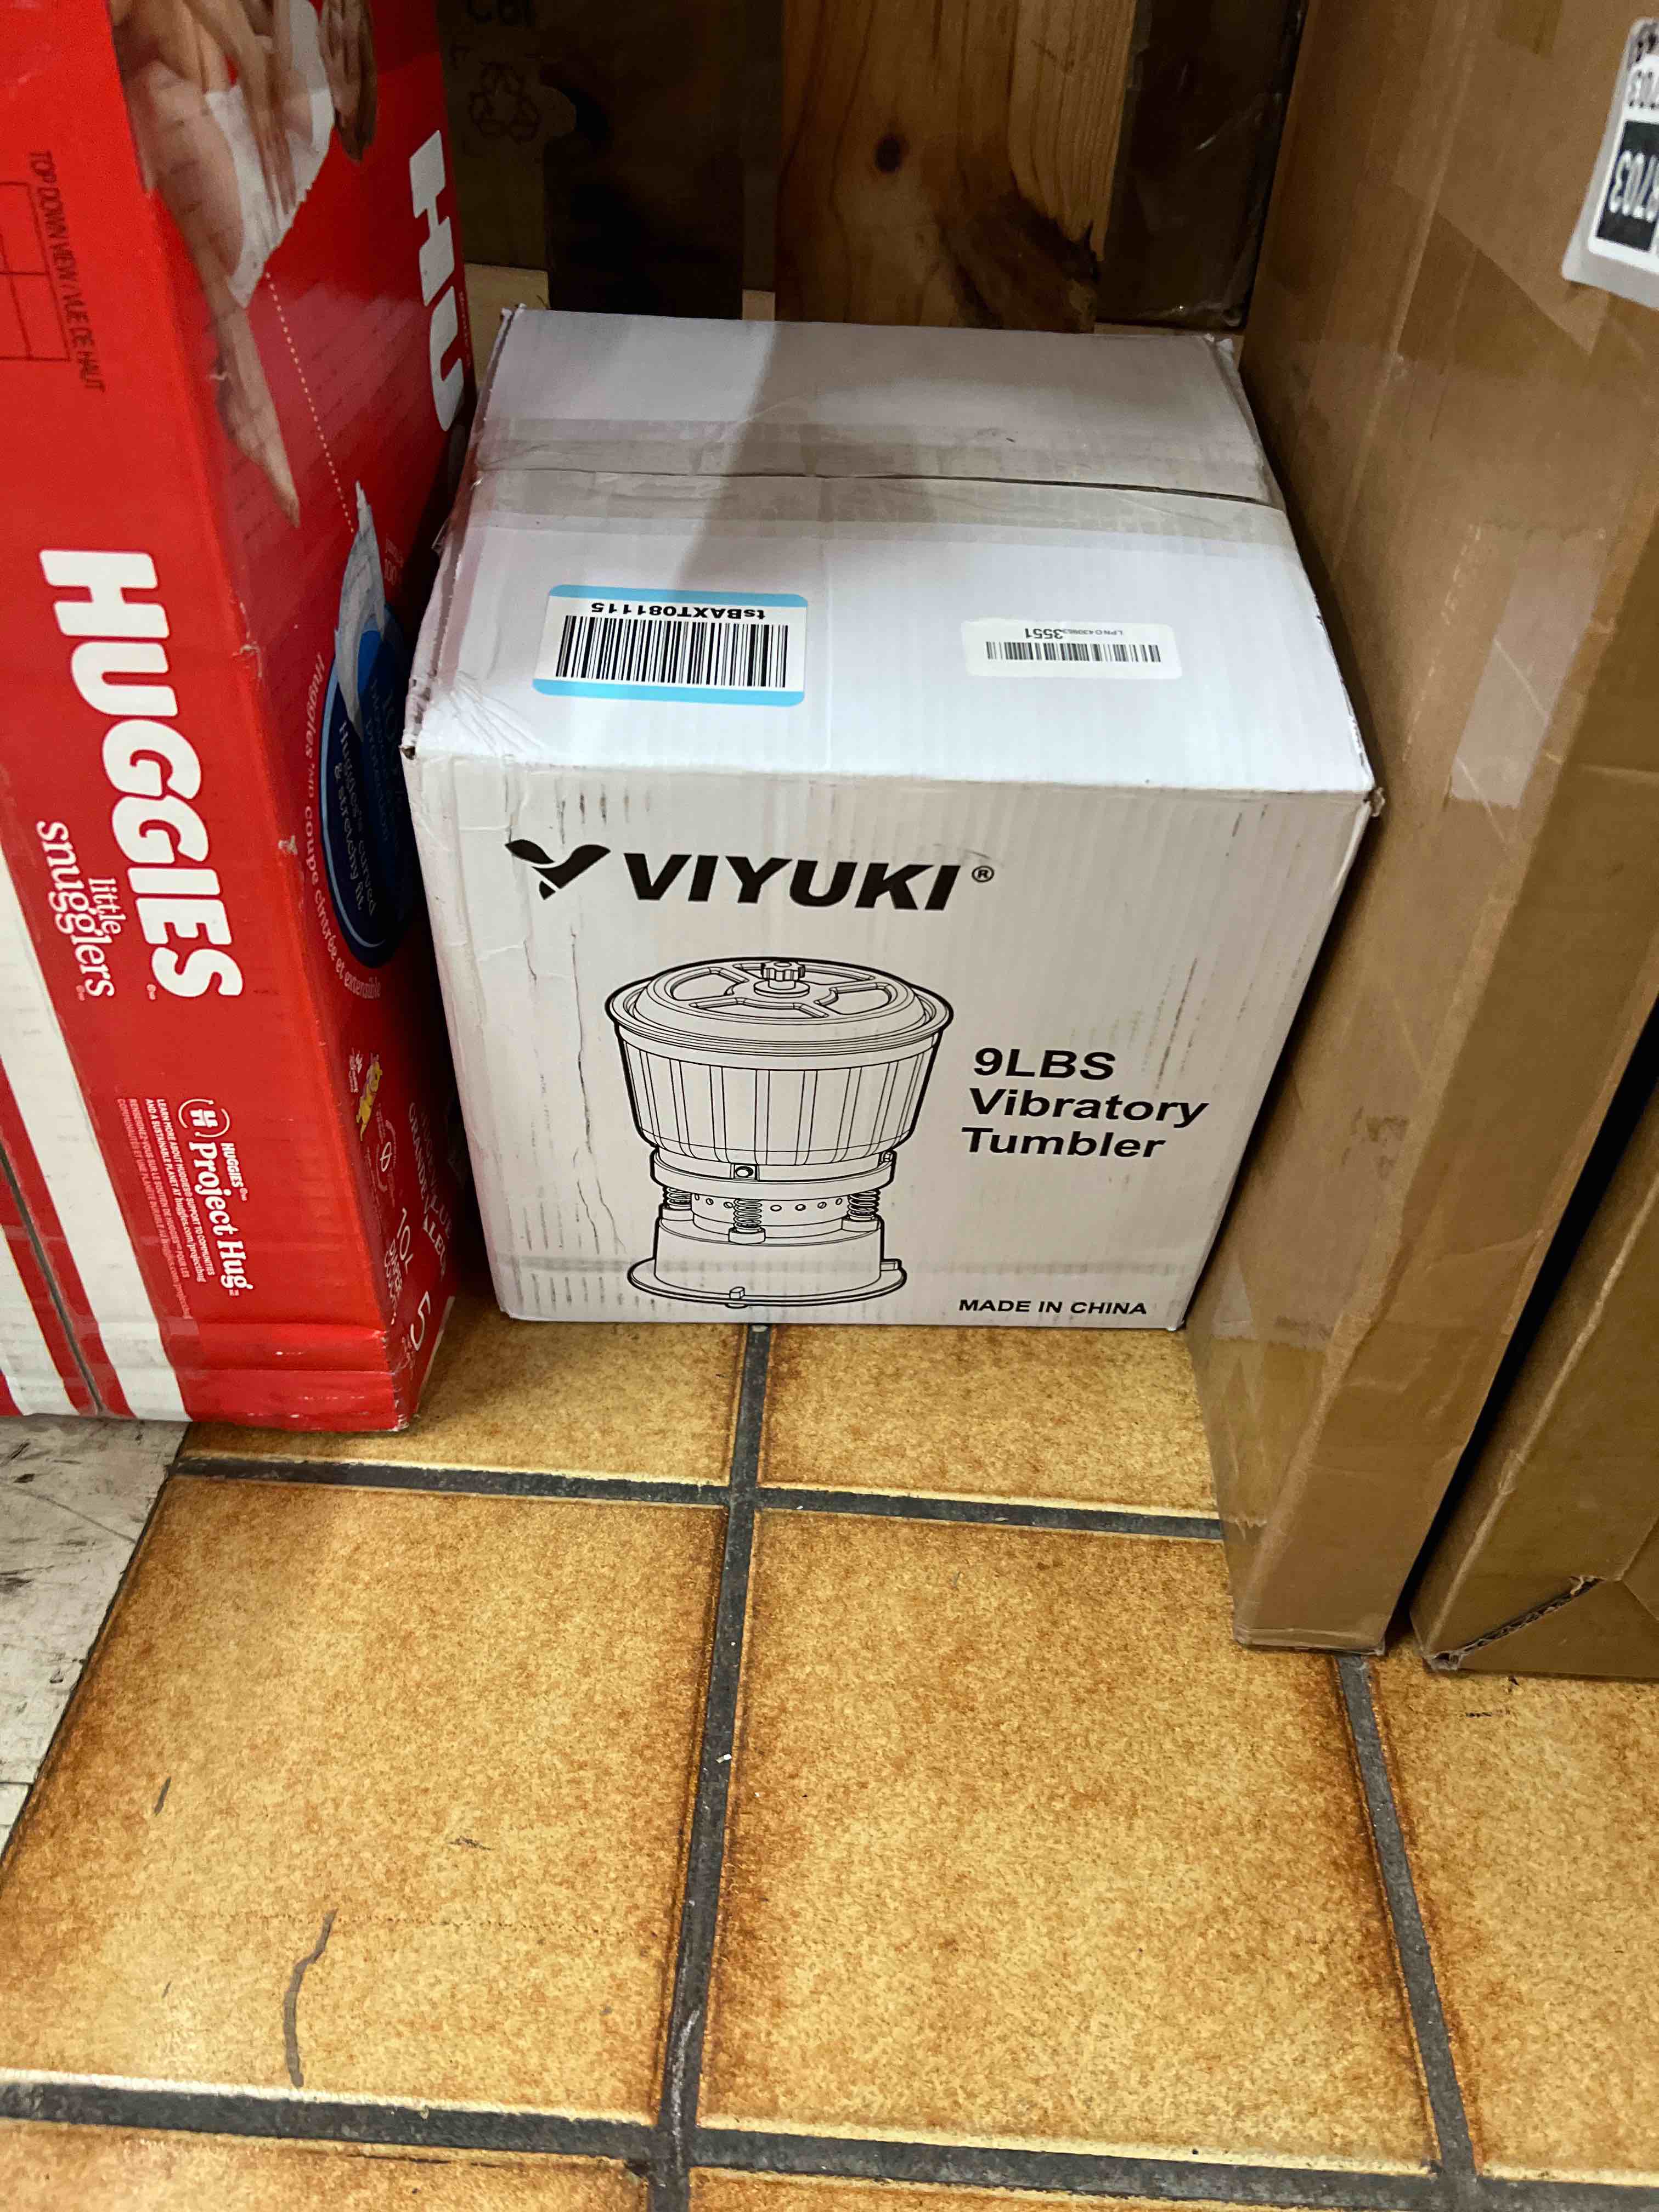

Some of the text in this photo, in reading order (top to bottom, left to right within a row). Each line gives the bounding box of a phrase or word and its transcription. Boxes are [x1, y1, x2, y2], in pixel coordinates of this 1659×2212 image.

[29, 150, 54, 184] TOP
[590, 601, 765, 620] tsBAXT081115
[39, 548, 244, 998] HUGGIES
[303, 805, 321, 885] coupe
[623, 853, 961, 911] VIYUKI
[36, 820, 115, 997] snugglers
[88, 877, 126, 934] little
[973, 1048, 1115, 1080] 9LBS
[156, 1099, 171, 1121] LEARN
[969, 1088, 1209, 1129] Vibratory
[145, 1099, 156, 1113] AND
[152, 1121, 171, 1163] SUSTAINABLE
[164, 1164, 177, 1187] PLANET
[163, 1122, 175, 1141] MORE
[961, 1127, 1166, 1159] Tumbler
[147, 1159, 157, 1172] SUR
[170, 1142, 183, 1163] ABOUT
[186, 1198, 200, 1226] SUPPORT
[189, 1142, 253, 1290] Project Hug
[197, 1235, 215, 1276] COMMUNITIES
[960, 1299, 1147, 1315] MADE IN CHINA
